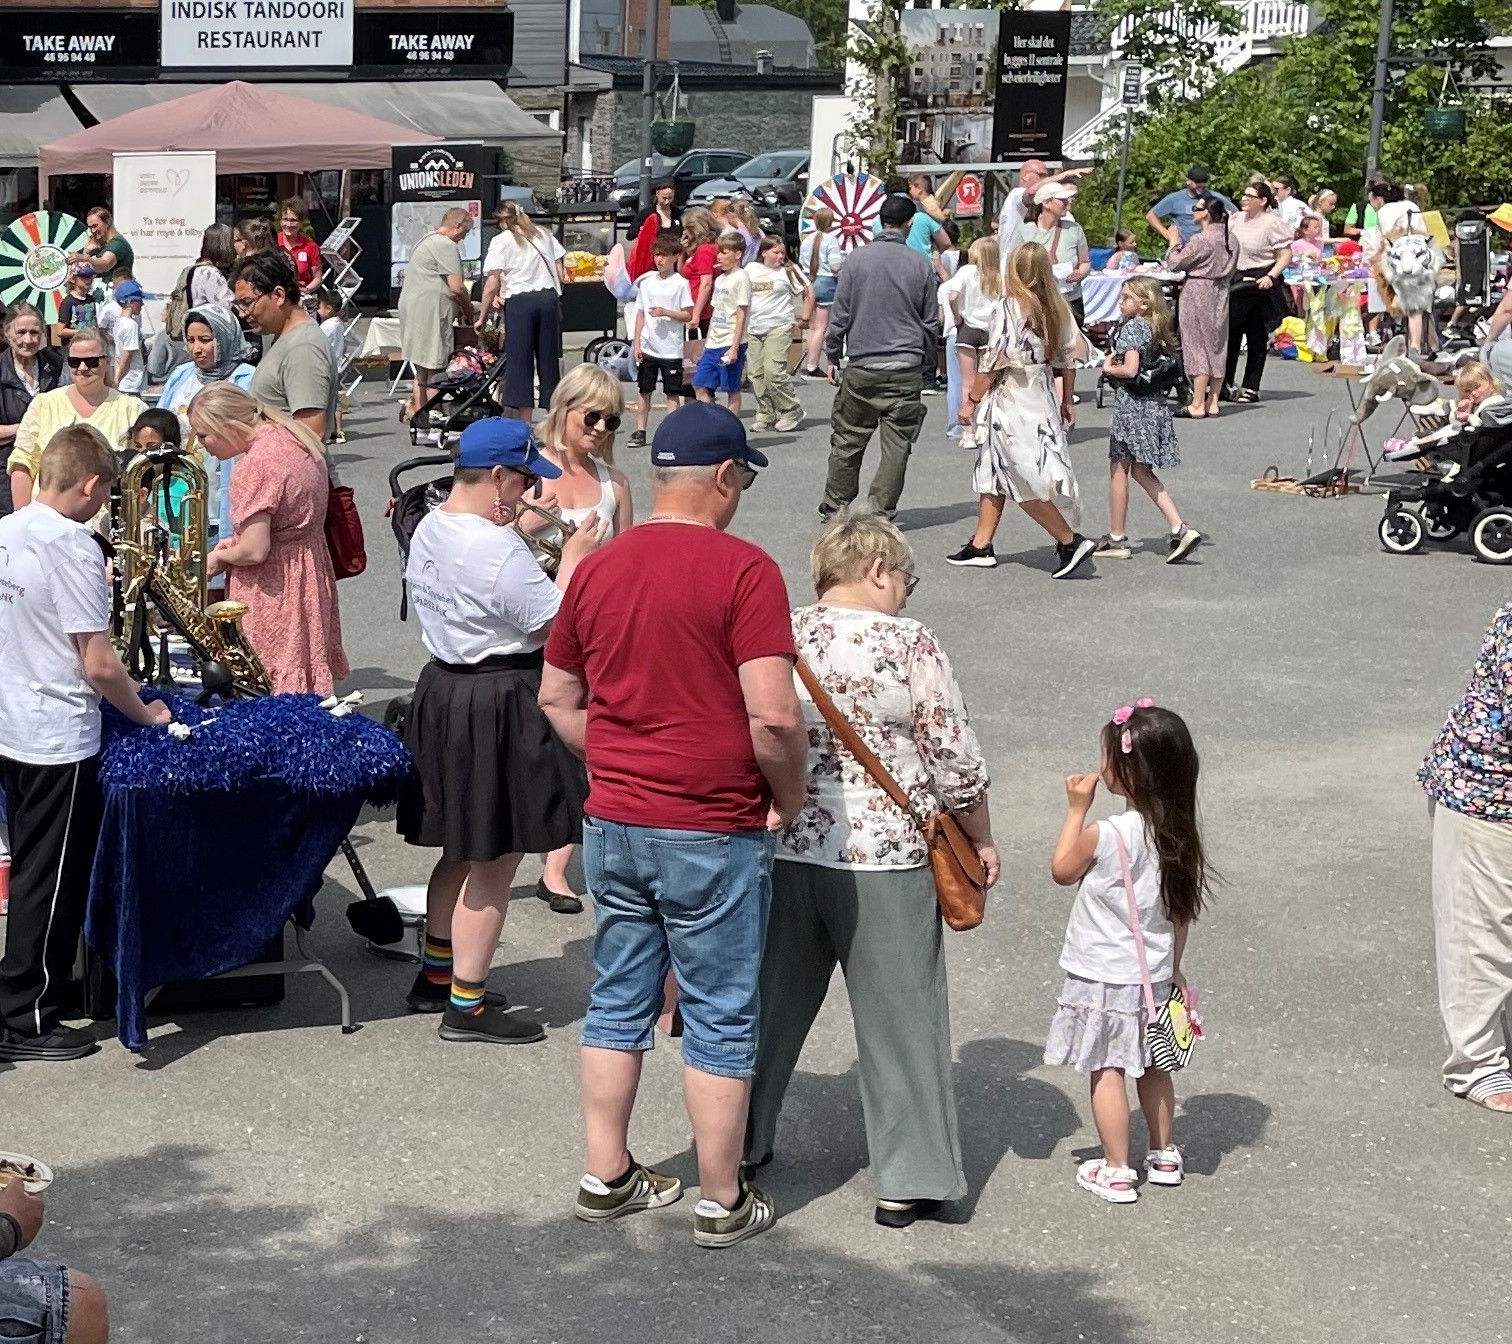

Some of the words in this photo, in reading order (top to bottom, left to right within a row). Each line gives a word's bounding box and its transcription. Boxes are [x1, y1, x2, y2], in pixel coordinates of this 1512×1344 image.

[171, 1, 237, 19] INDISK
[244, 1, 345, 19] TANDOORI
[22, 35, 65, 51] TAKE
[68, 35, 116, 51] AWAY
[197, 30, 323, 48] RESTAURANT
[389, 34, 428, 50] TAKE
[430, 34, 475, 50] AWAY
[399, 170, 475, 191] UNIONSLEDEN
